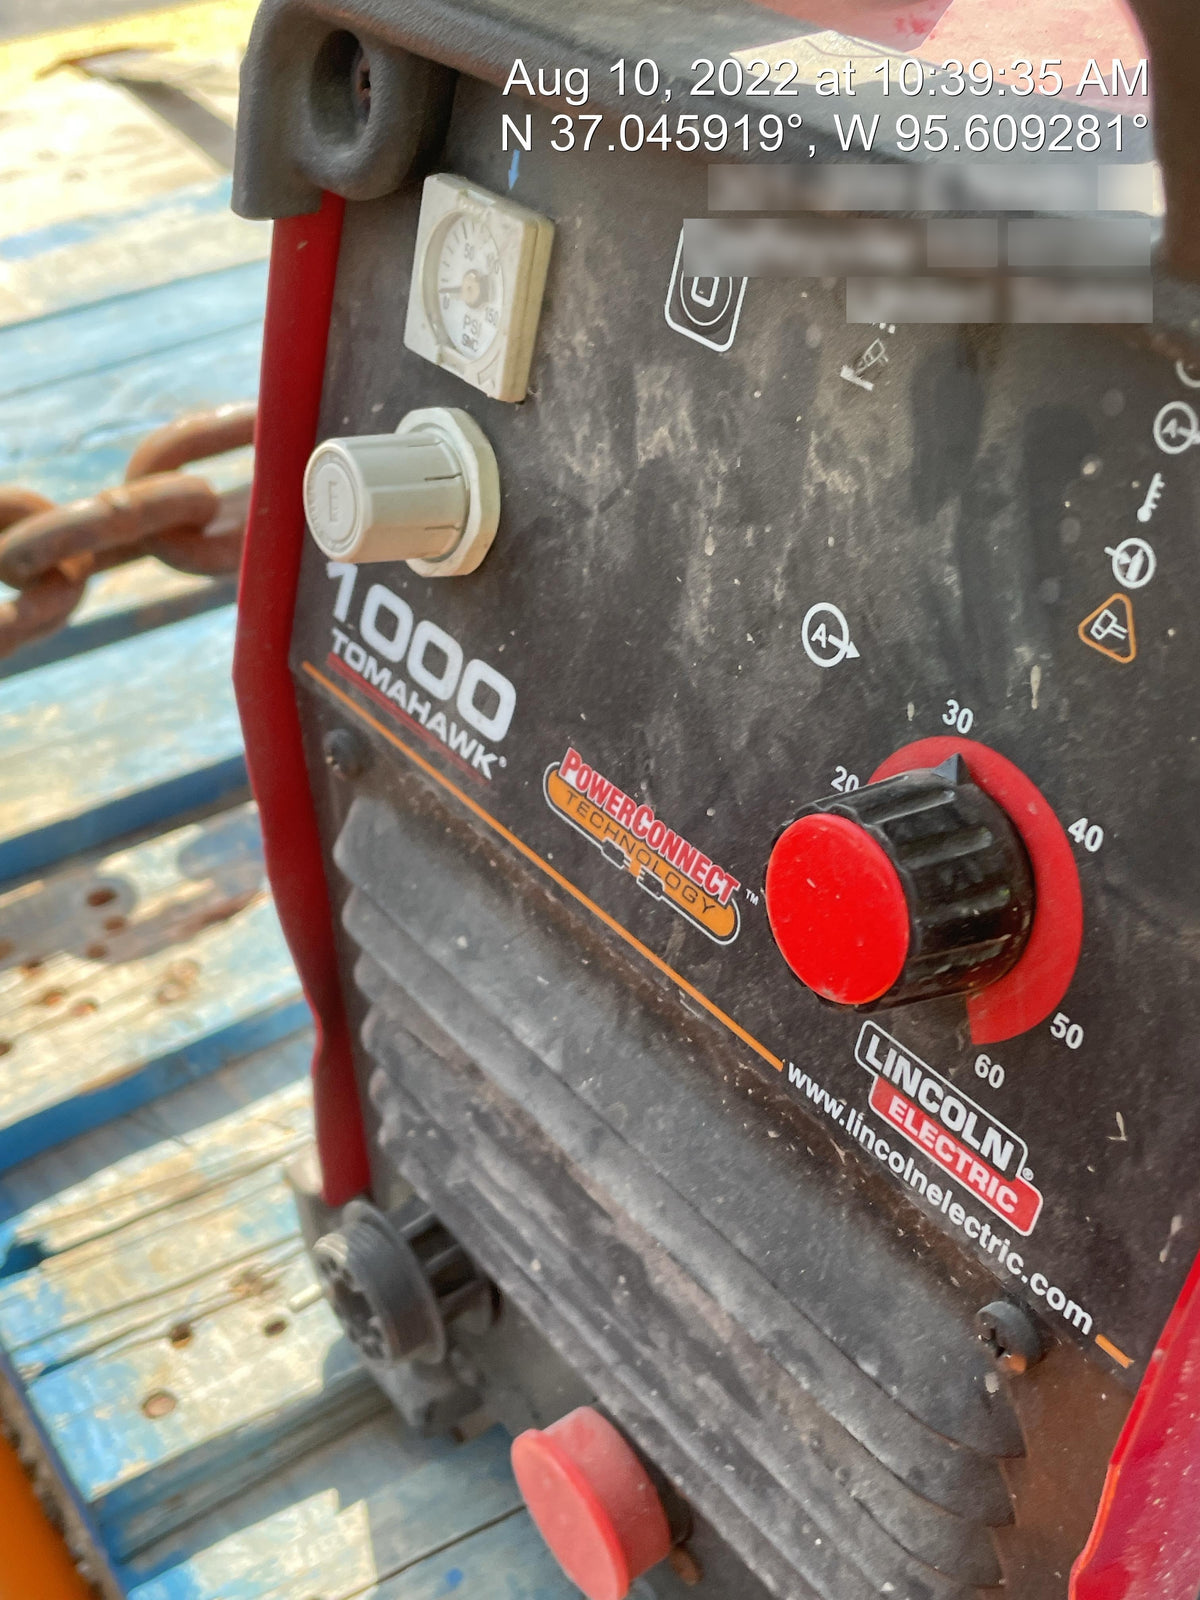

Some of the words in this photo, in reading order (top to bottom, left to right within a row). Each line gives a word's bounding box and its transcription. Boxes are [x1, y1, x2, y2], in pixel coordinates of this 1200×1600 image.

[462, 314, 483, 338] PSI
[326, 561, 517, 742] 1000
[942, 699, 974, 734] 30
[565, 790, 717, 915] TECHNOLOGY
[1068, 817, 1104, 852] 40
[1050, 1012, 1084, 1049] 50
[865, 1034, 1014, 1172] LINCOLN
[973, 1053, 1006, 1089] 60
[887, 1095, 1019, 1213] ELECTRIC
[787, 1061, 1093, 1335] www.lincolnelectric.com
